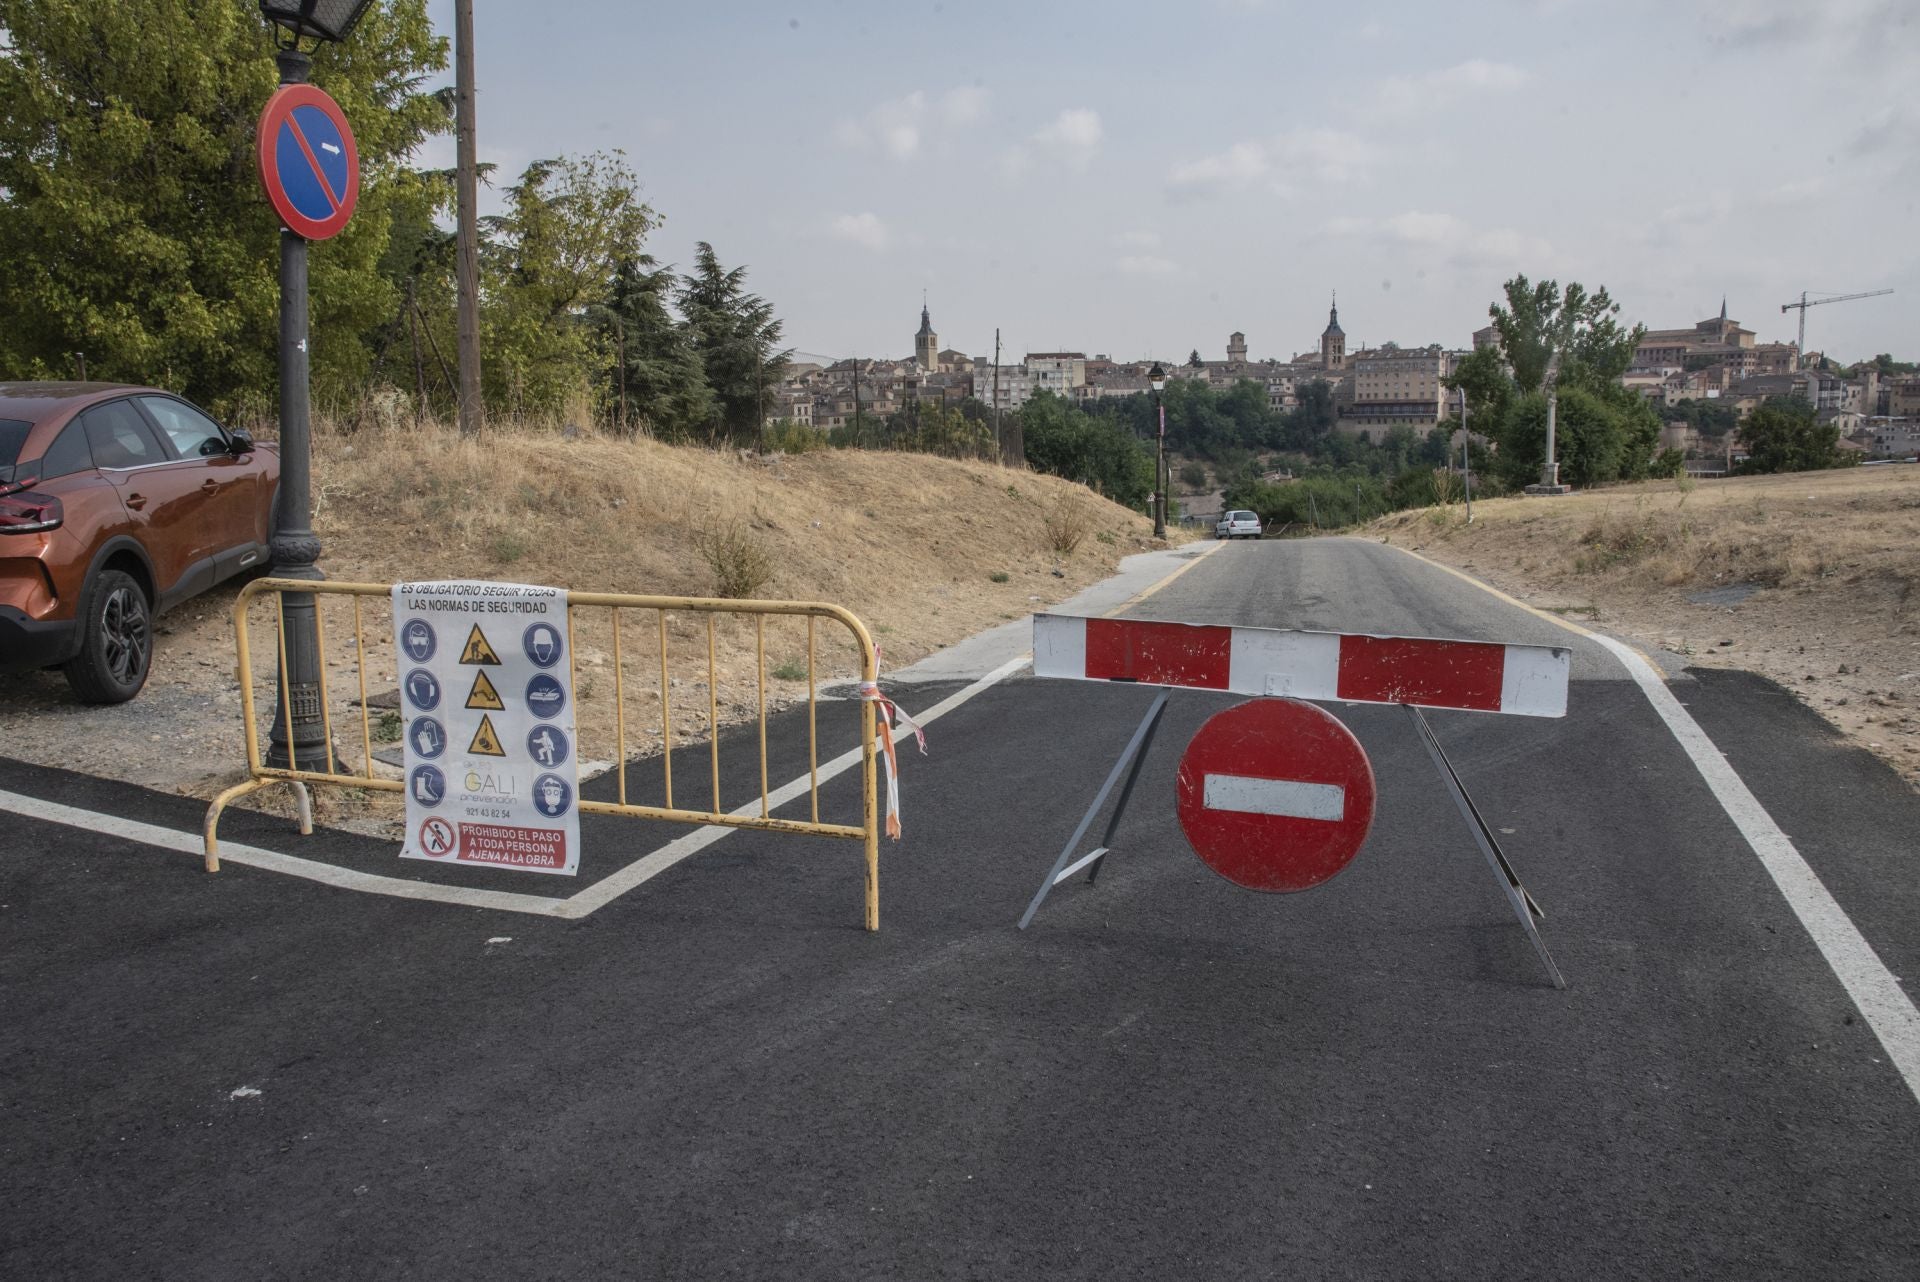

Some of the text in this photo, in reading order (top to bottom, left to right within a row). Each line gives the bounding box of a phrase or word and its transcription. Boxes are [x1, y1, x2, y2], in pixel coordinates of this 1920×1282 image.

[401, 584, 556, 598] ES OBLIGATORIO SEGUIR TODAS
[408, 599, 547, 614] LAS NORMAS DE SEGURIDAD
[464, 772, 515, 795] GALI
[480, 808, 489, 817] 43
[501, 809, 511, 819] 54
[462, 825, 561, 842] PROHIBIDO EL PASO
[469, 838, 556, 854] A TODA PERSONA
[468, 850, 555, 866] AJENA A LA OBRA
